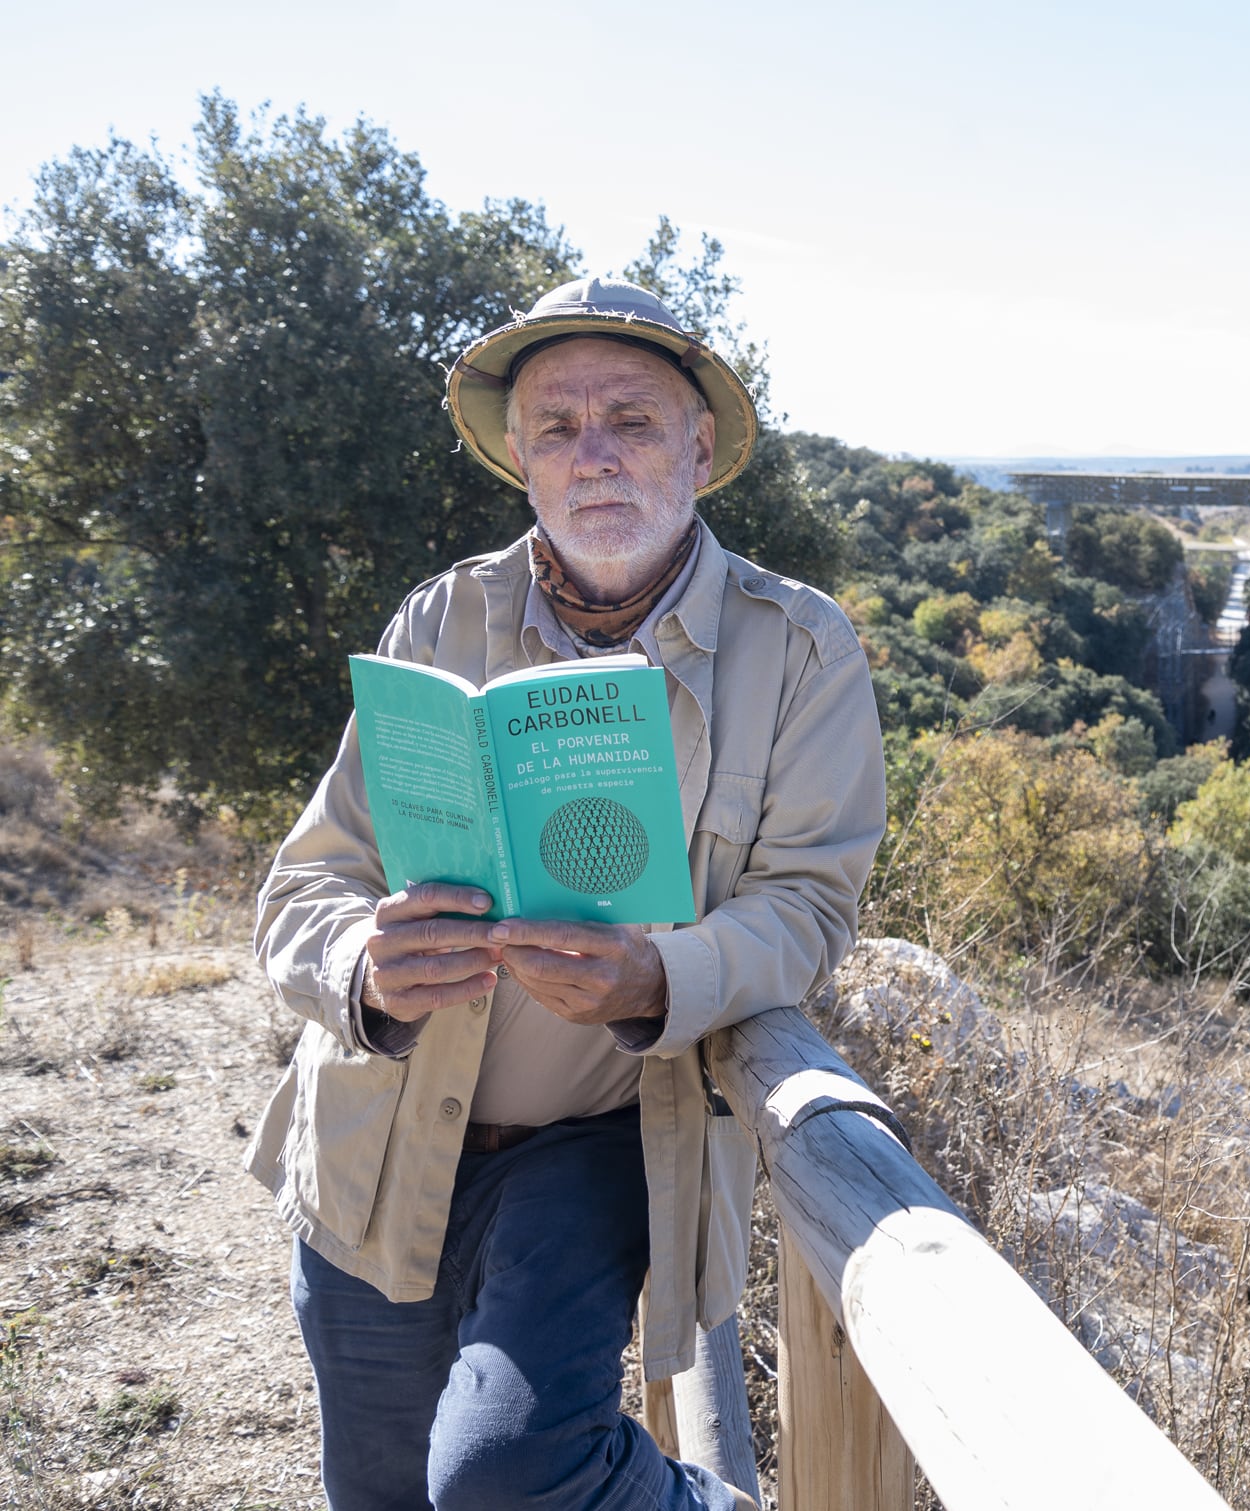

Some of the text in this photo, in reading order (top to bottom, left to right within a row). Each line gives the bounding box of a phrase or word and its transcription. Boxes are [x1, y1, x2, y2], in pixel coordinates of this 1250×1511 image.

[527, 682, 619, 709] EUDALD
[507, 704, 647, 736] CARBONELL
[531, 733, 630, 754] EL PORVENIR
[473, 708, 499, 813] EUDALD CARBONELL
[516, 749, 650, 775] DE LA HUMANIDAD
[554, 772, 576, 781] para
[595, 766, 663, 776] supervivencia
[541, 779, 634, 794] de nuestra especie
[400, 801, 424, 812] CLAVES
[426, 806, 443, 816] PARA
